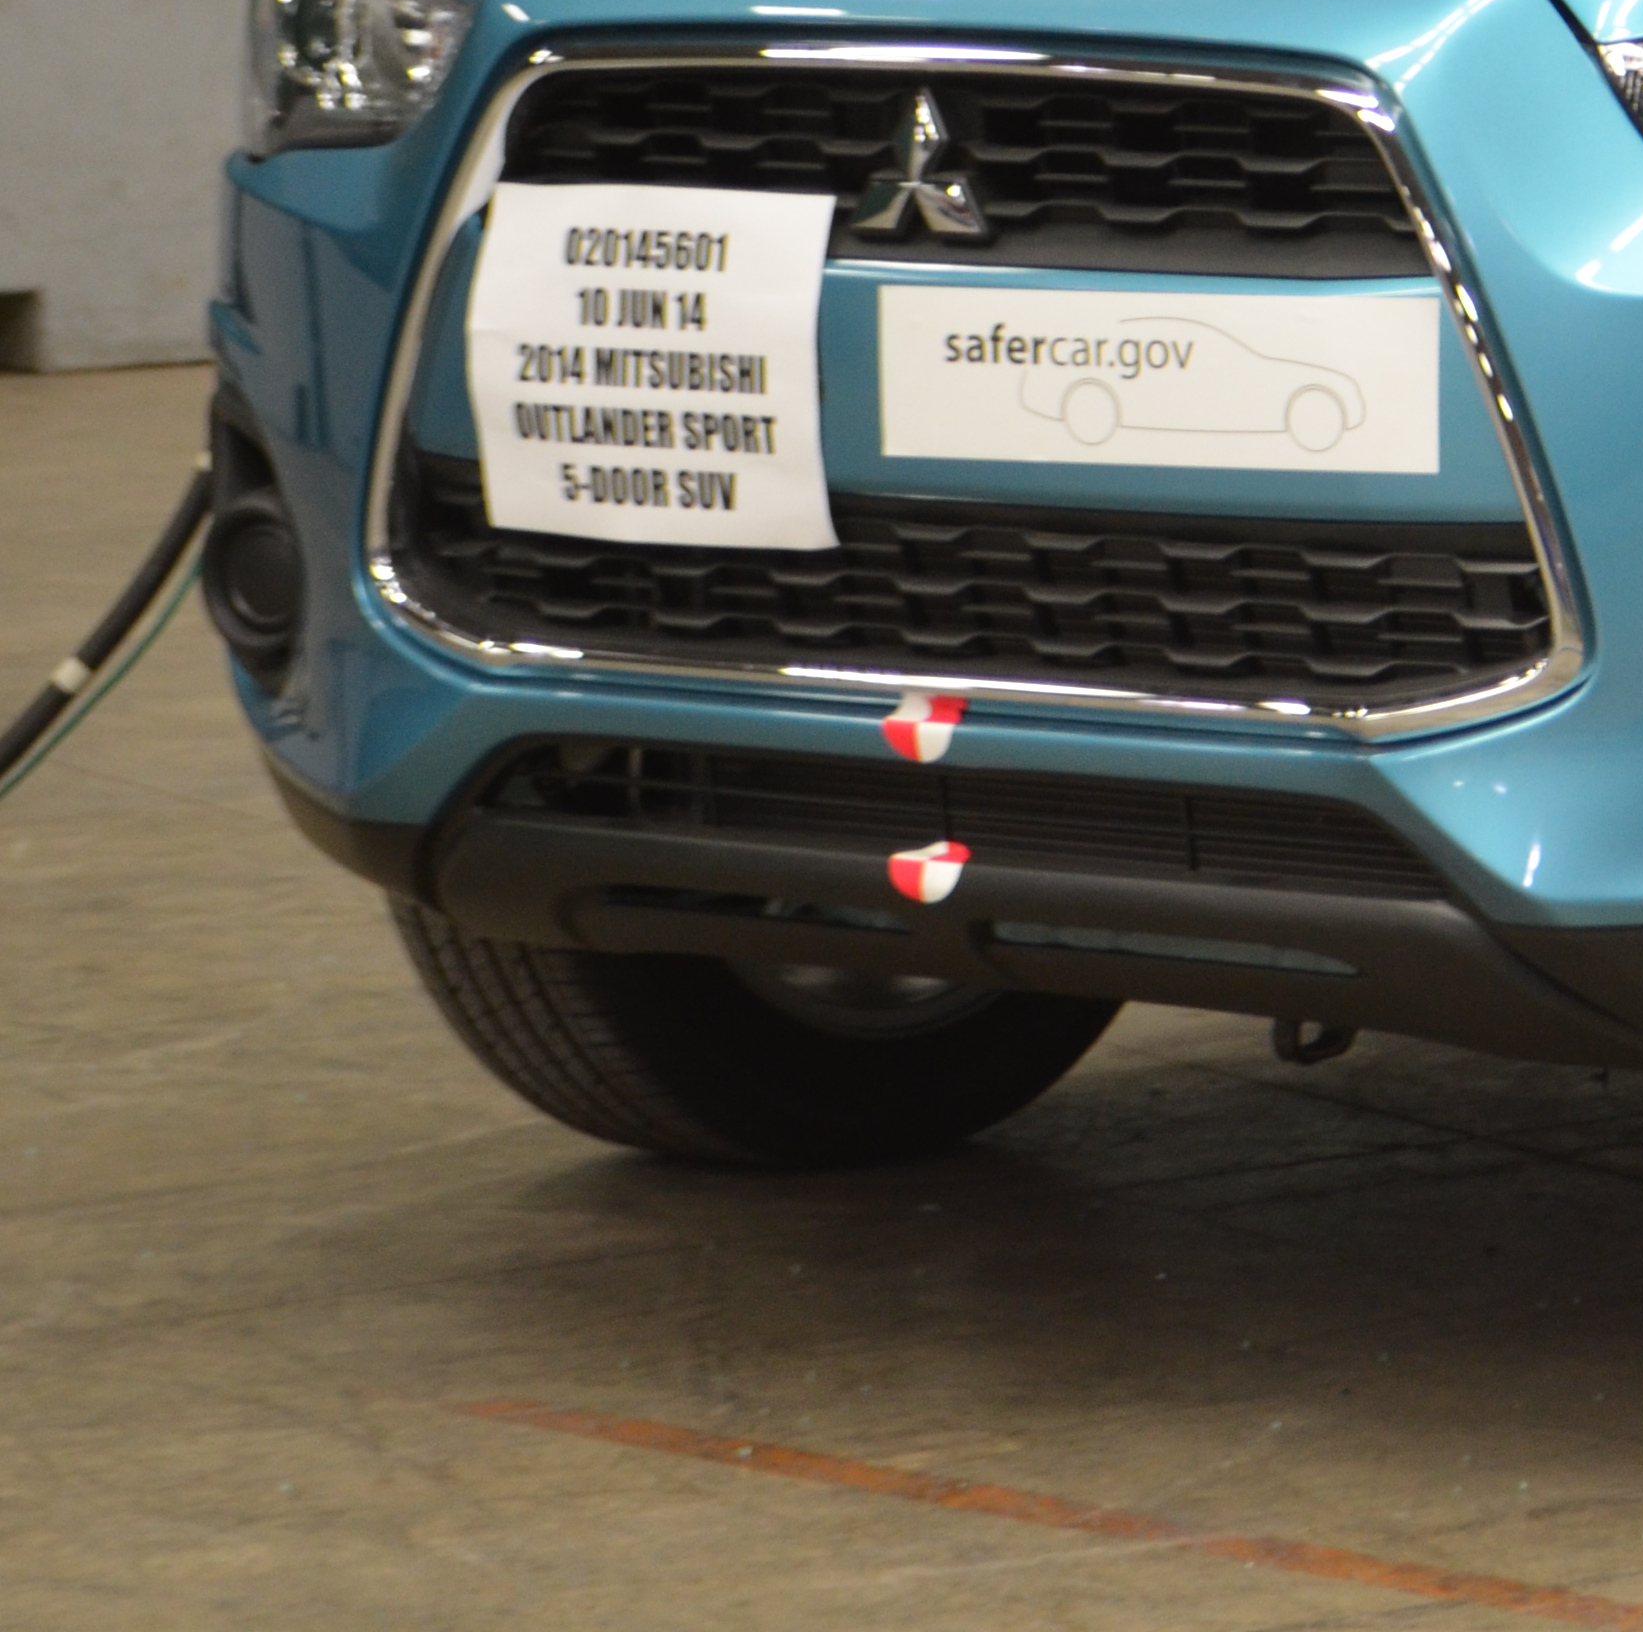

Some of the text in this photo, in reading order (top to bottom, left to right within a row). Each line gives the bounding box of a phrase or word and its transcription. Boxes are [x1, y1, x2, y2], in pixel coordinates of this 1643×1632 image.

[564, 227, 729, 272] 020145601
[578, 288, 707, 331] 10 JUN 14
[517, 343, 767, 395] 2014 MITSUBISHI
[944, 323, 1195, 379] safercar.gov
[513, 402, 777, 455] OUTLANDER SPORT
[561, 463, 737, 511] 5-DOOR SUV
